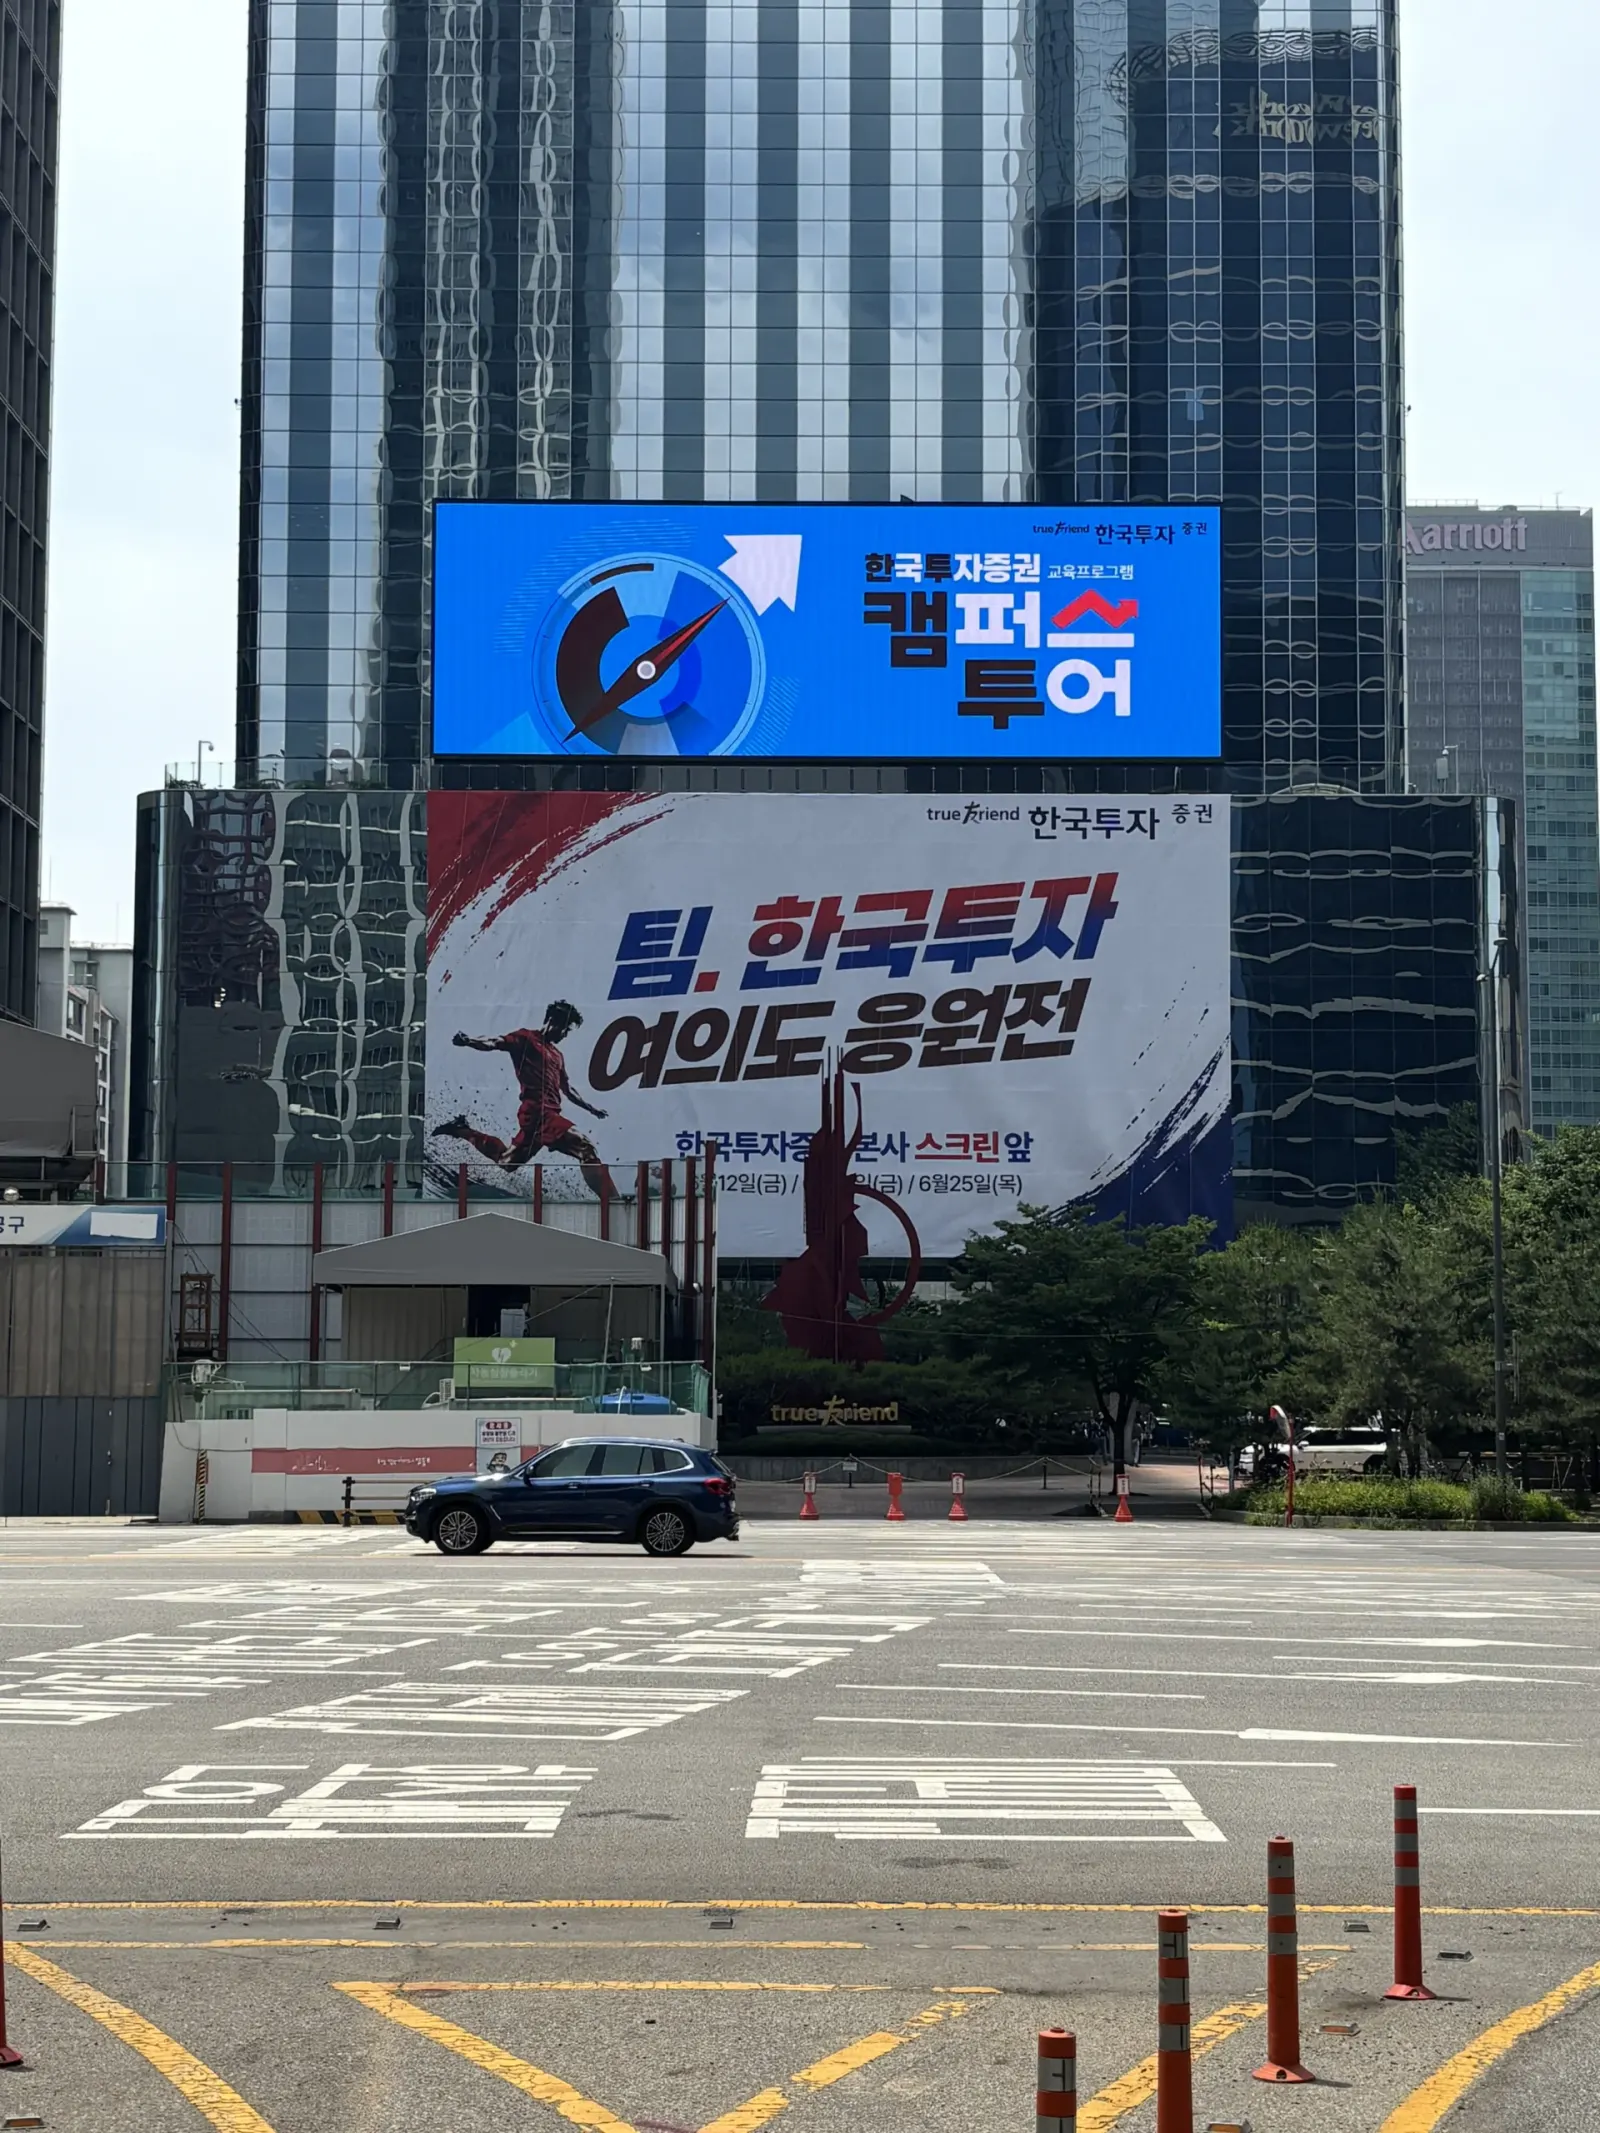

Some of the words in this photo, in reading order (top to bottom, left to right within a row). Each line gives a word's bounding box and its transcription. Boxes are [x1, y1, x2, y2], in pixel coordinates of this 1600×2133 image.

[1095, 523, 1176, 545] 한국투자
[1181, 522, 1208, 535] 증권
[864, 553, 1040, 583] 한국투자증권
[1047, 564, 1134, 581] 교육프로그램
[863, 589, 1139, 668] 캠퍼스
[957, 658, 1132, 730] 투어
[1028, 806, 1160, 840] 한국투자
[1171, 803, 1213, 824] 증권
[588, 1000, 836, 1092] 여의도
[841, 977, 1092, 1075] 응원전
[853, 1130, 910, 1164] 본사
[919, 1173, 1023, 1197] 6월25일(목)
